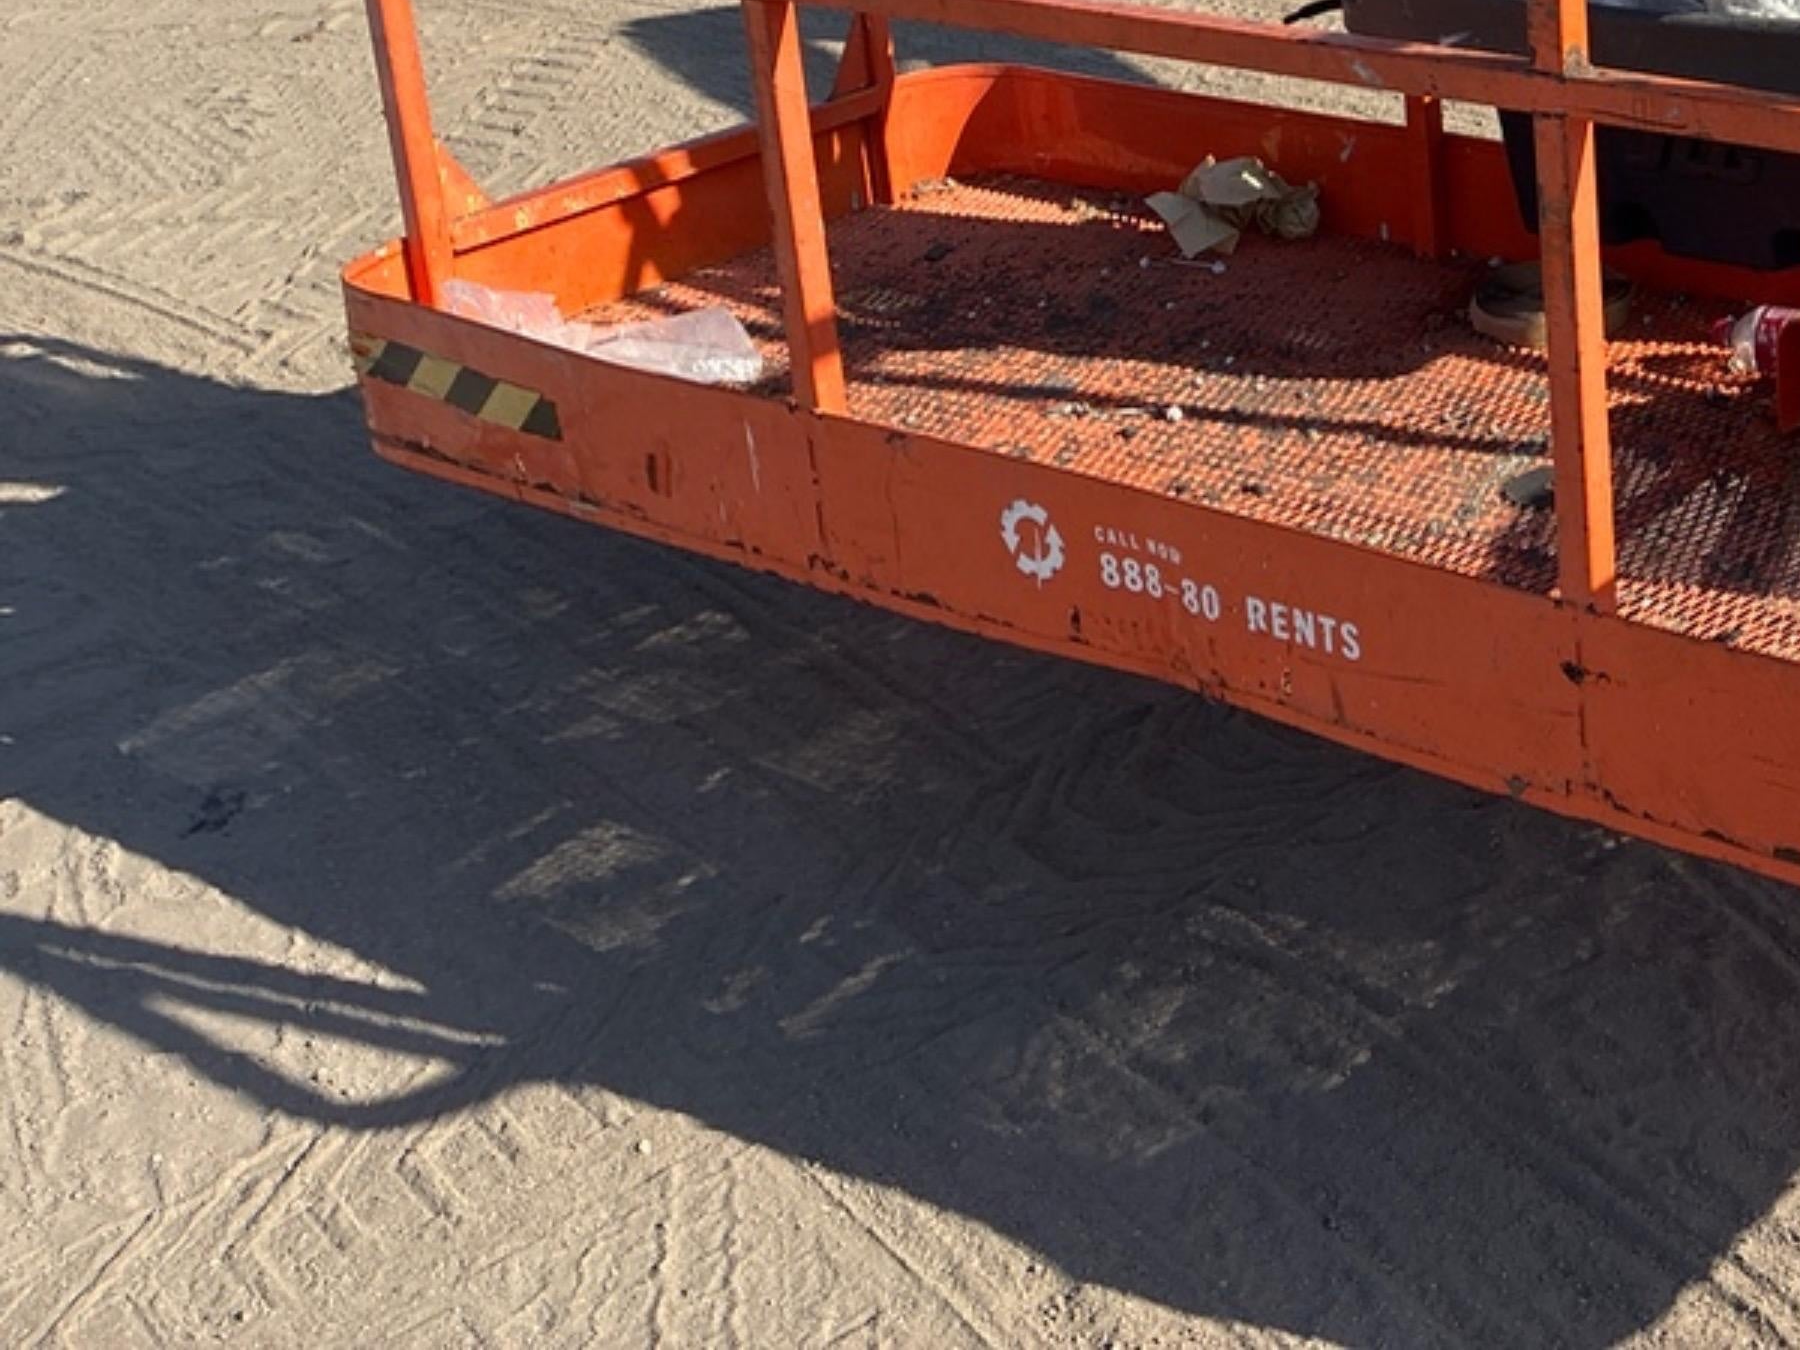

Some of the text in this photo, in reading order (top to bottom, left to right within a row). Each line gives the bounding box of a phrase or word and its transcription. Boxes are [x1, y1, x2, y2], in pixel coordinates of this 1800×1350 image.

[1094, 525, 1141, 551] CALL
[1099, 552, 1362, 662] 888-80 RENTS
